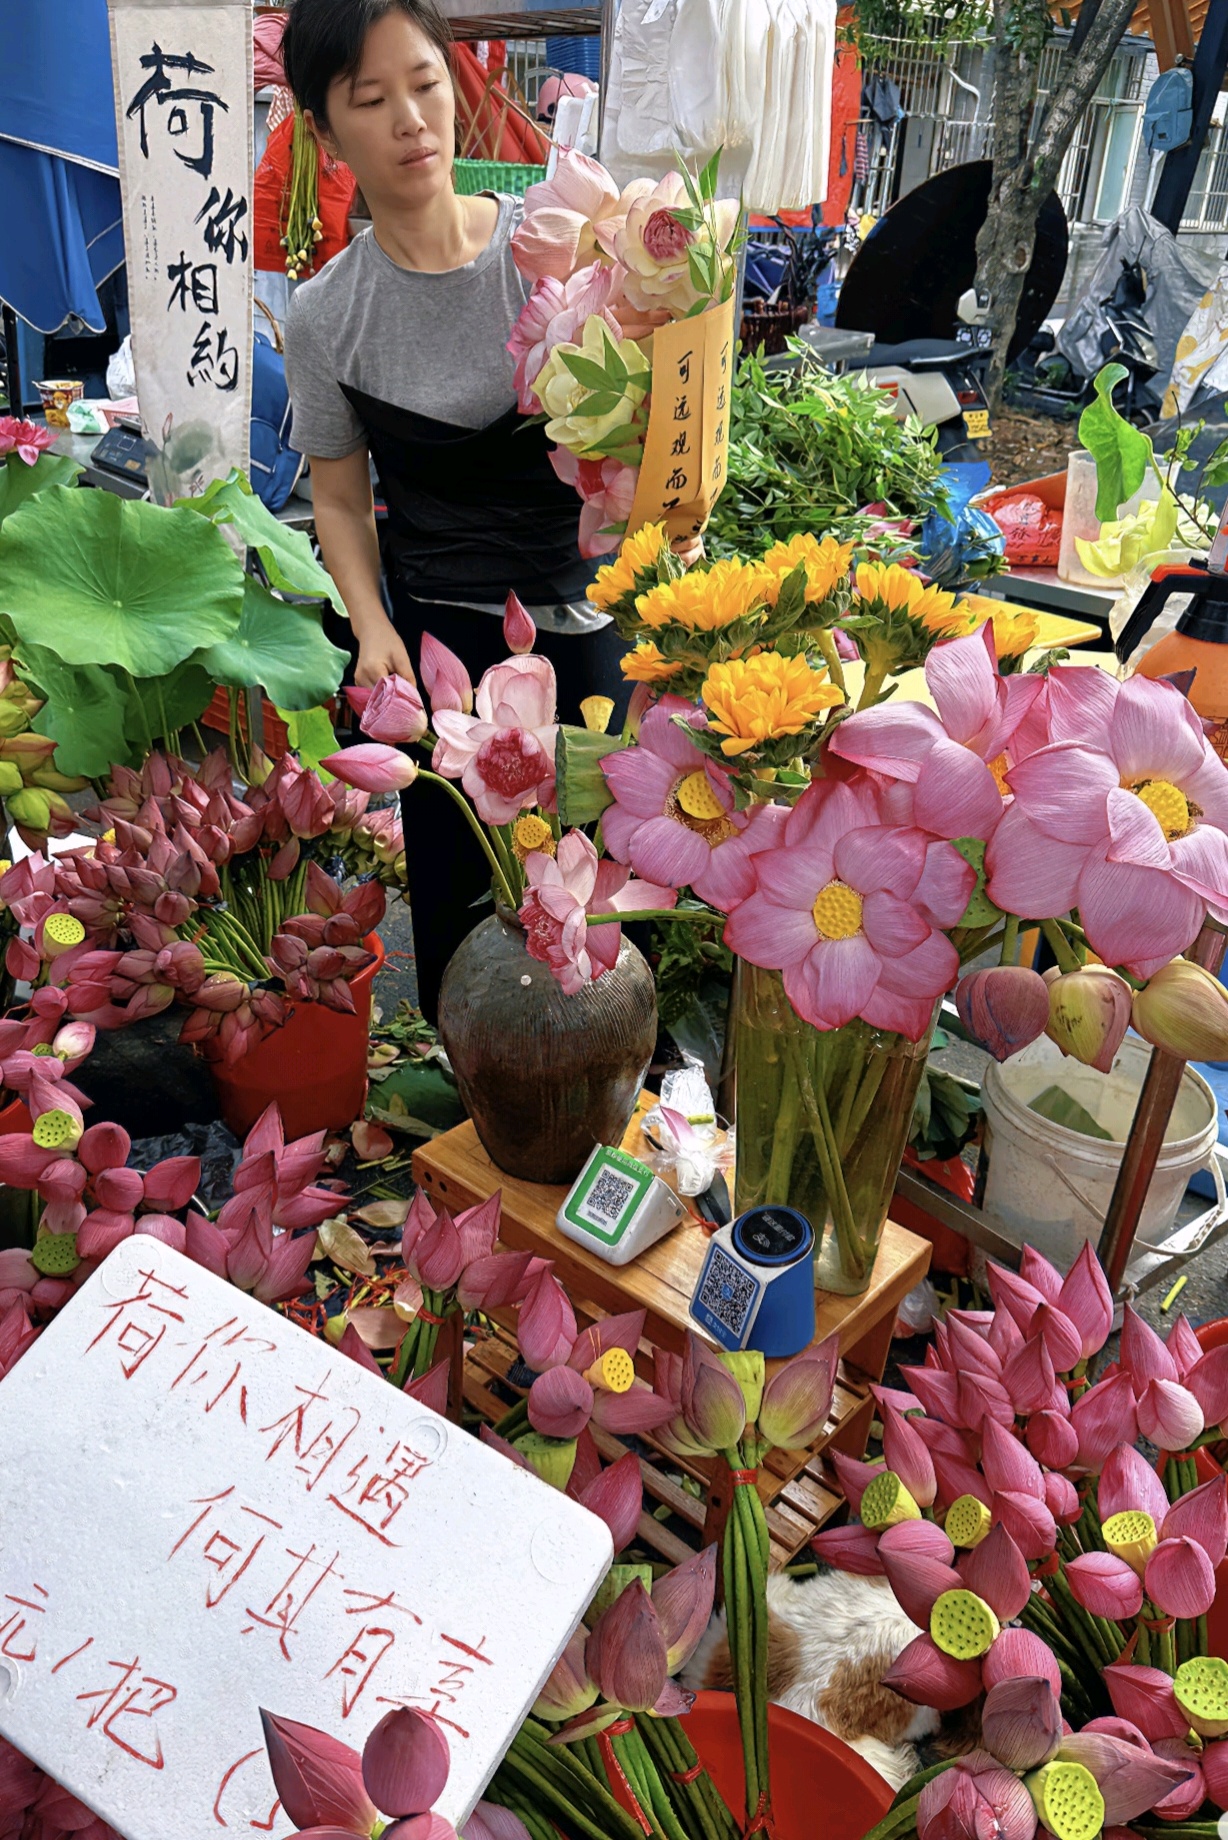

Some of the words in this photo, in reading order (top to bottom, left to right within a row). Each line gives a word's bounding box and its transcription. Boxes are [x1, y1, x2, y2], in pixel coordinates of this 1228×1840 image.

[126, 40, 248, 393] 荷你相約
[86, 1269, 429, 1547] 荷你相遇
